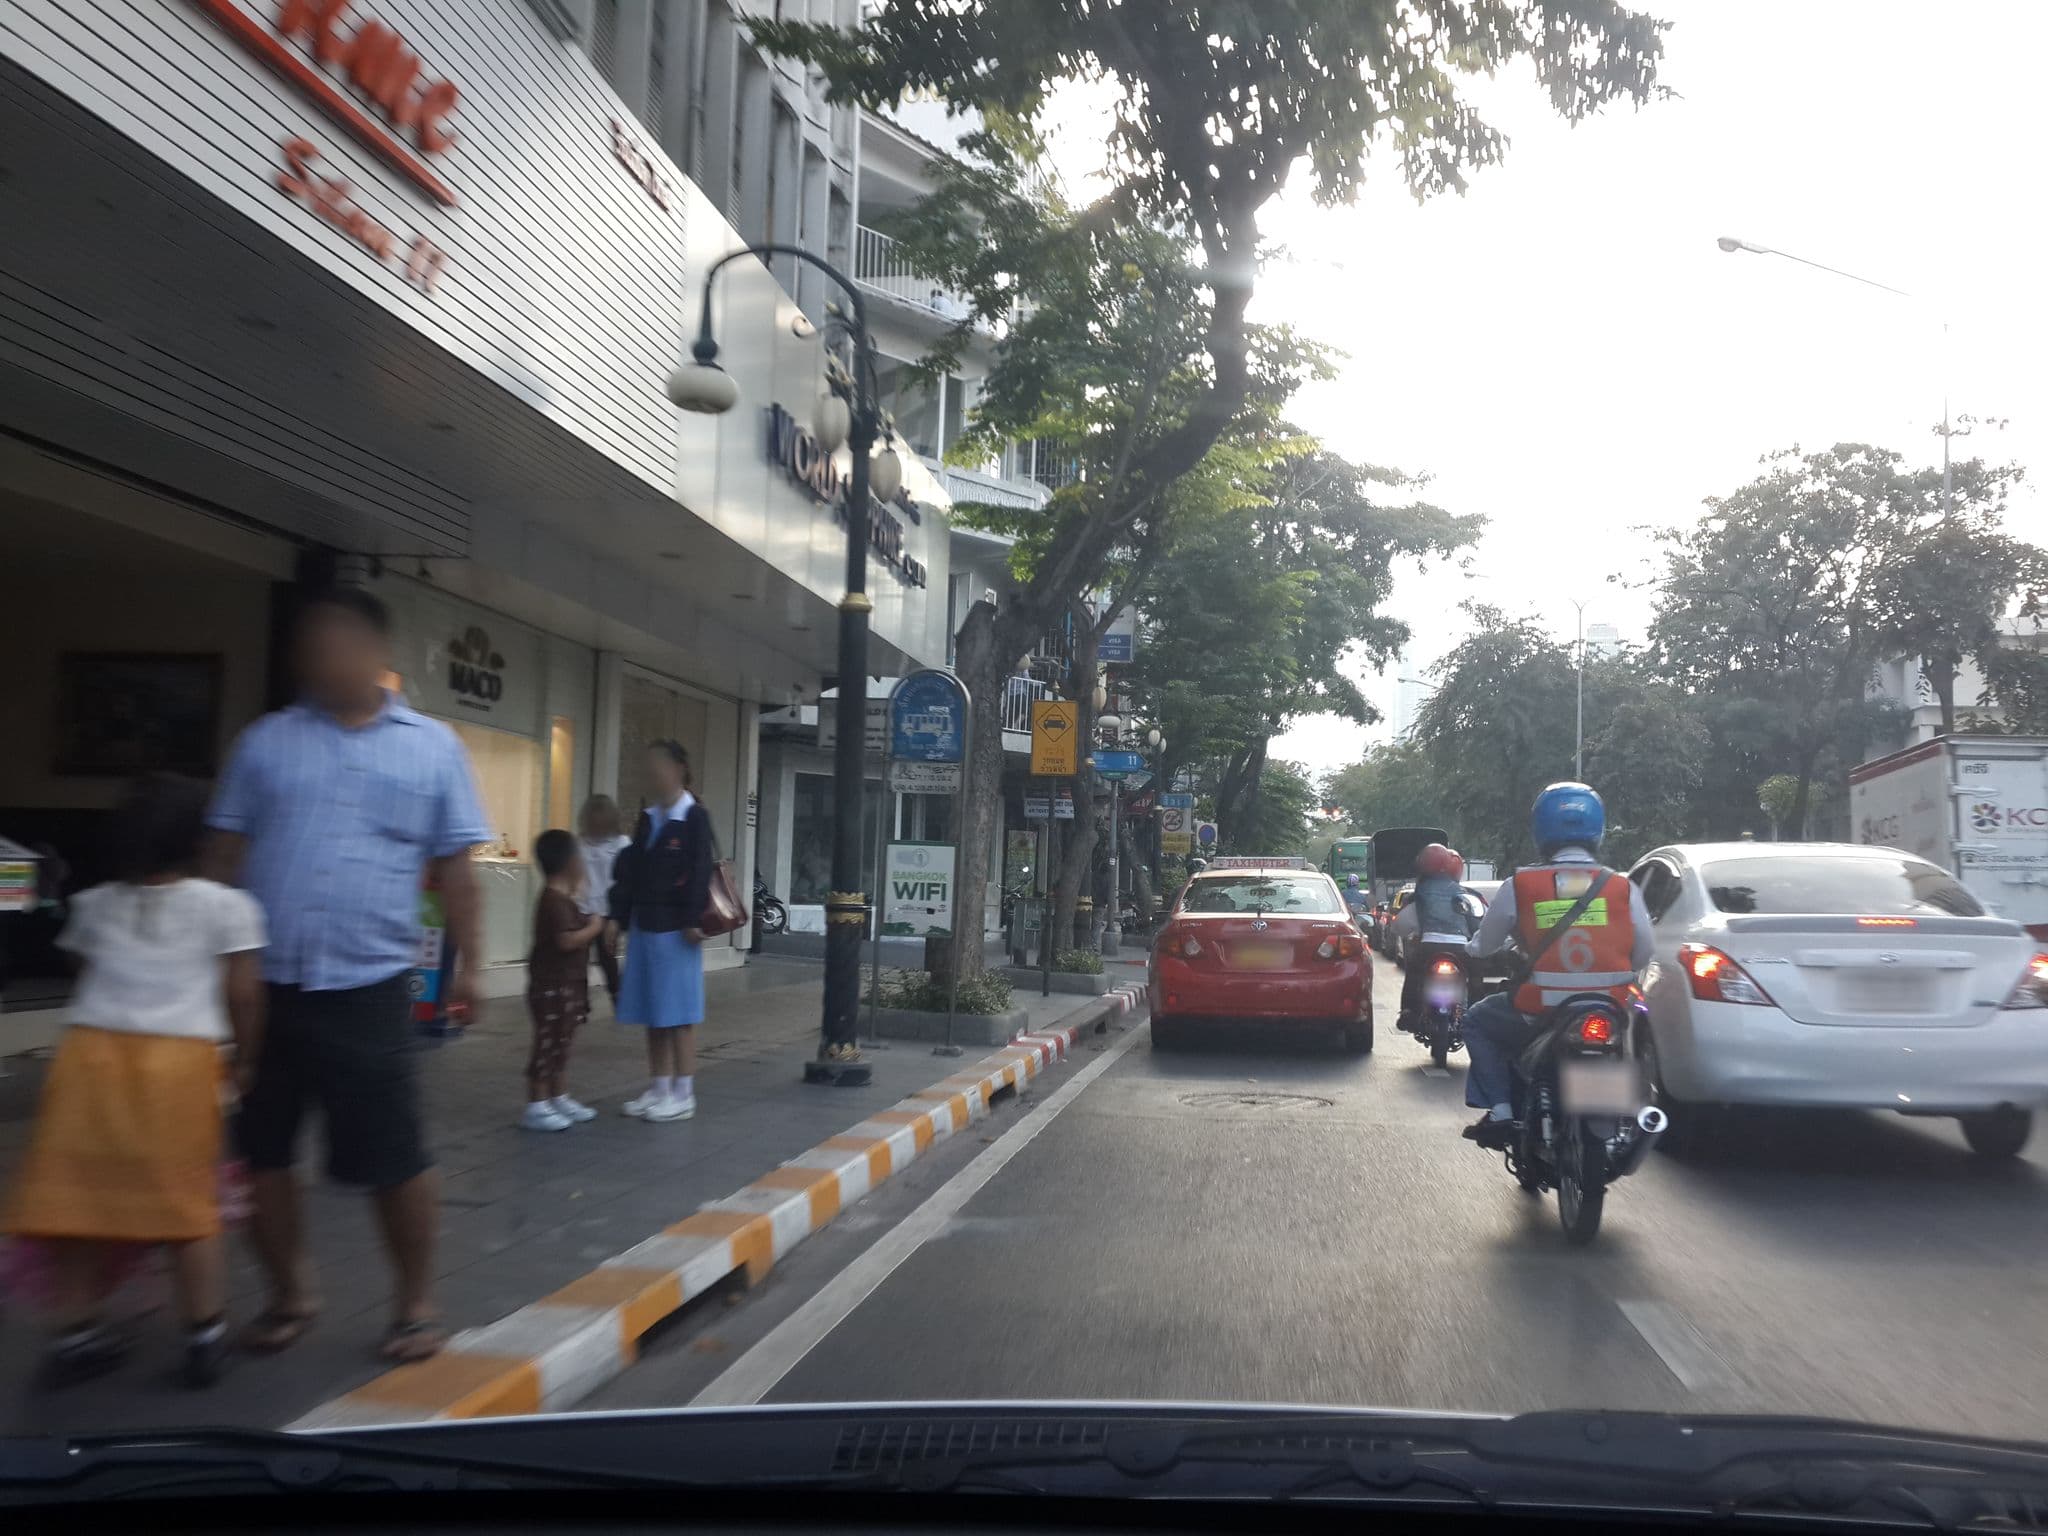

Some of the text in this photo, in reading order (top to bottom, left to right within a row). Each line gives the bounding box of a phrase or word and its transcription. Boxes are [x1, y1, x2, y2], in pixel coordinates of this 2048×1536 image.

[1127, 755, 1137, 766] 11
[892, 871, 948, 881] BANGKOK
[892, 881, 948, 902] WIFI
[1558, 928, 1595, 973] 6
